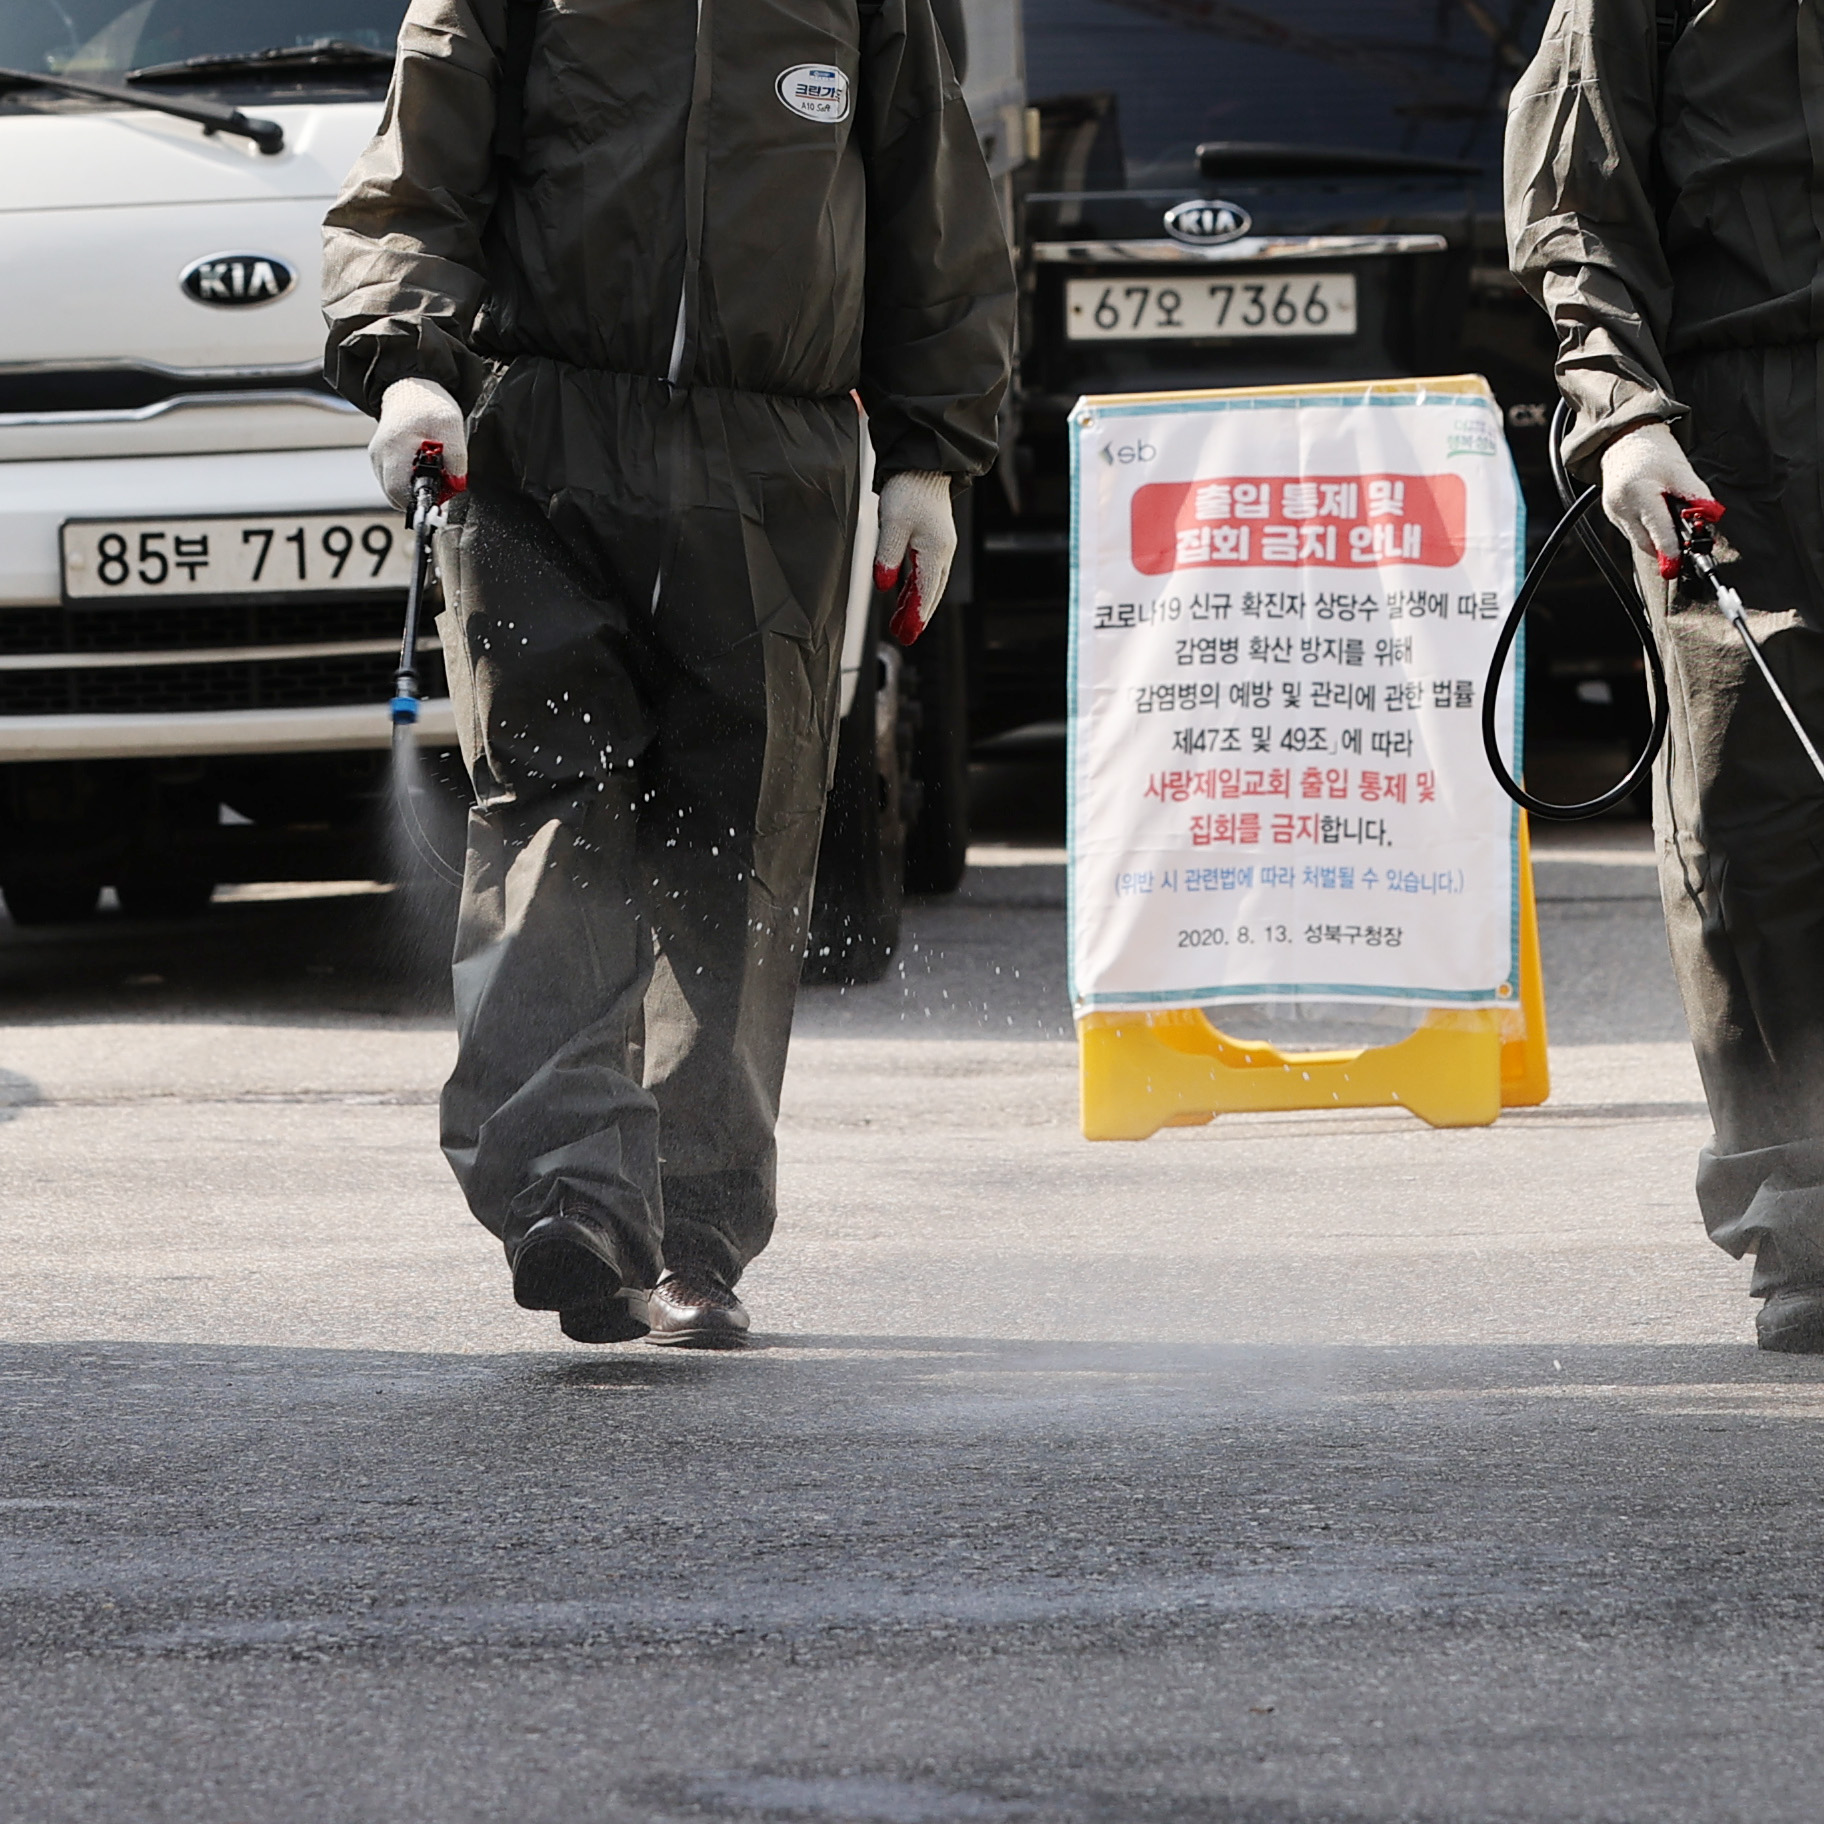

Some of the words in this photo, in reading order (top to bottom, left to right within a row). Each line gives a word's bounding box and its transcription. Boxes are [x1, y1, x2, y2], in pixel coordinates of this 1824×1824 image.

[801, 102, 815, 111] A10
[1180, 210, 1236, 234] KIA
[198, 261, 283, 298] KIA
[1093, 286, 1182, 331] 67오
[1209, 283, 1330, 328] 7366
[1194, 481, 1272, 521] 출입
[1281, 481, 1358, 520] 통제
[1367, 479, 1406, 518] 및
[96, 531, 209, 586] 85부
[242, 524, 394, 582] 7199
[1176, 524, 1250, 564] 집회
[1261, 524, 1337, 562] 금지
[1349, 522, 1422, 563] 안내
[1094, 597, 1182, 630] 코로나19
[1189, 592, 1233, 620] 신규
[1240, 590, 1306, 619] 확진자
[1314, 591, 1380, 622] 상당수
[1386, 589, 1449, 620] 발생에
[1457, 591, 1500, 621] 따른
[1175, 635, 1239, 666] 감염병
[1248, 634, 1293, 664] 확산
[1301, 635, 1365, 667] 방지를
[1374, 635, 1413, 666] 위해
[1229, 679, 1272, 709] 예방
[1282, 681, 1301, 709] 및
[1310, 680, 1376, 712] 관리에
[1384, 680, 1424, 712] 관한
[1432, 678, 1475, 709] 법률
[1172, 726, 1241, 755] 제47조
[1251, 725, 1272, 754] 및
[1371, 728, 1414, 757] 따라
[1144, 767, 1291, 803] 사랑제일교회
[1300, 766, 1349, 800] 출입
[1358, 769, 1408, 804] 통제
[1416, 769, 1436, 804] 및
[1189, 812, 1261, 847] 집회를
[1270, 812, 1393, 847] 금지합니다.
[1114, 868, 1154, 897] (위반
[1161, 868, 1177, 894] 시
[1184, 865, 1254, 892] 관련법에
[1260, 864, 1296, 889] 따라
[1302, 865, 1355, 890] 처벌될
[1361, 867, 1380, 890] 수
[1386, 868, 1464, 895] 있습니다.)
[1178, 927, 1229, 948] 2020.
[1236, 925, 1255, 945] 8.
[1264, 923, 1293, 944] 13.
[1304, 923, 1403, 948] 성북구청장
